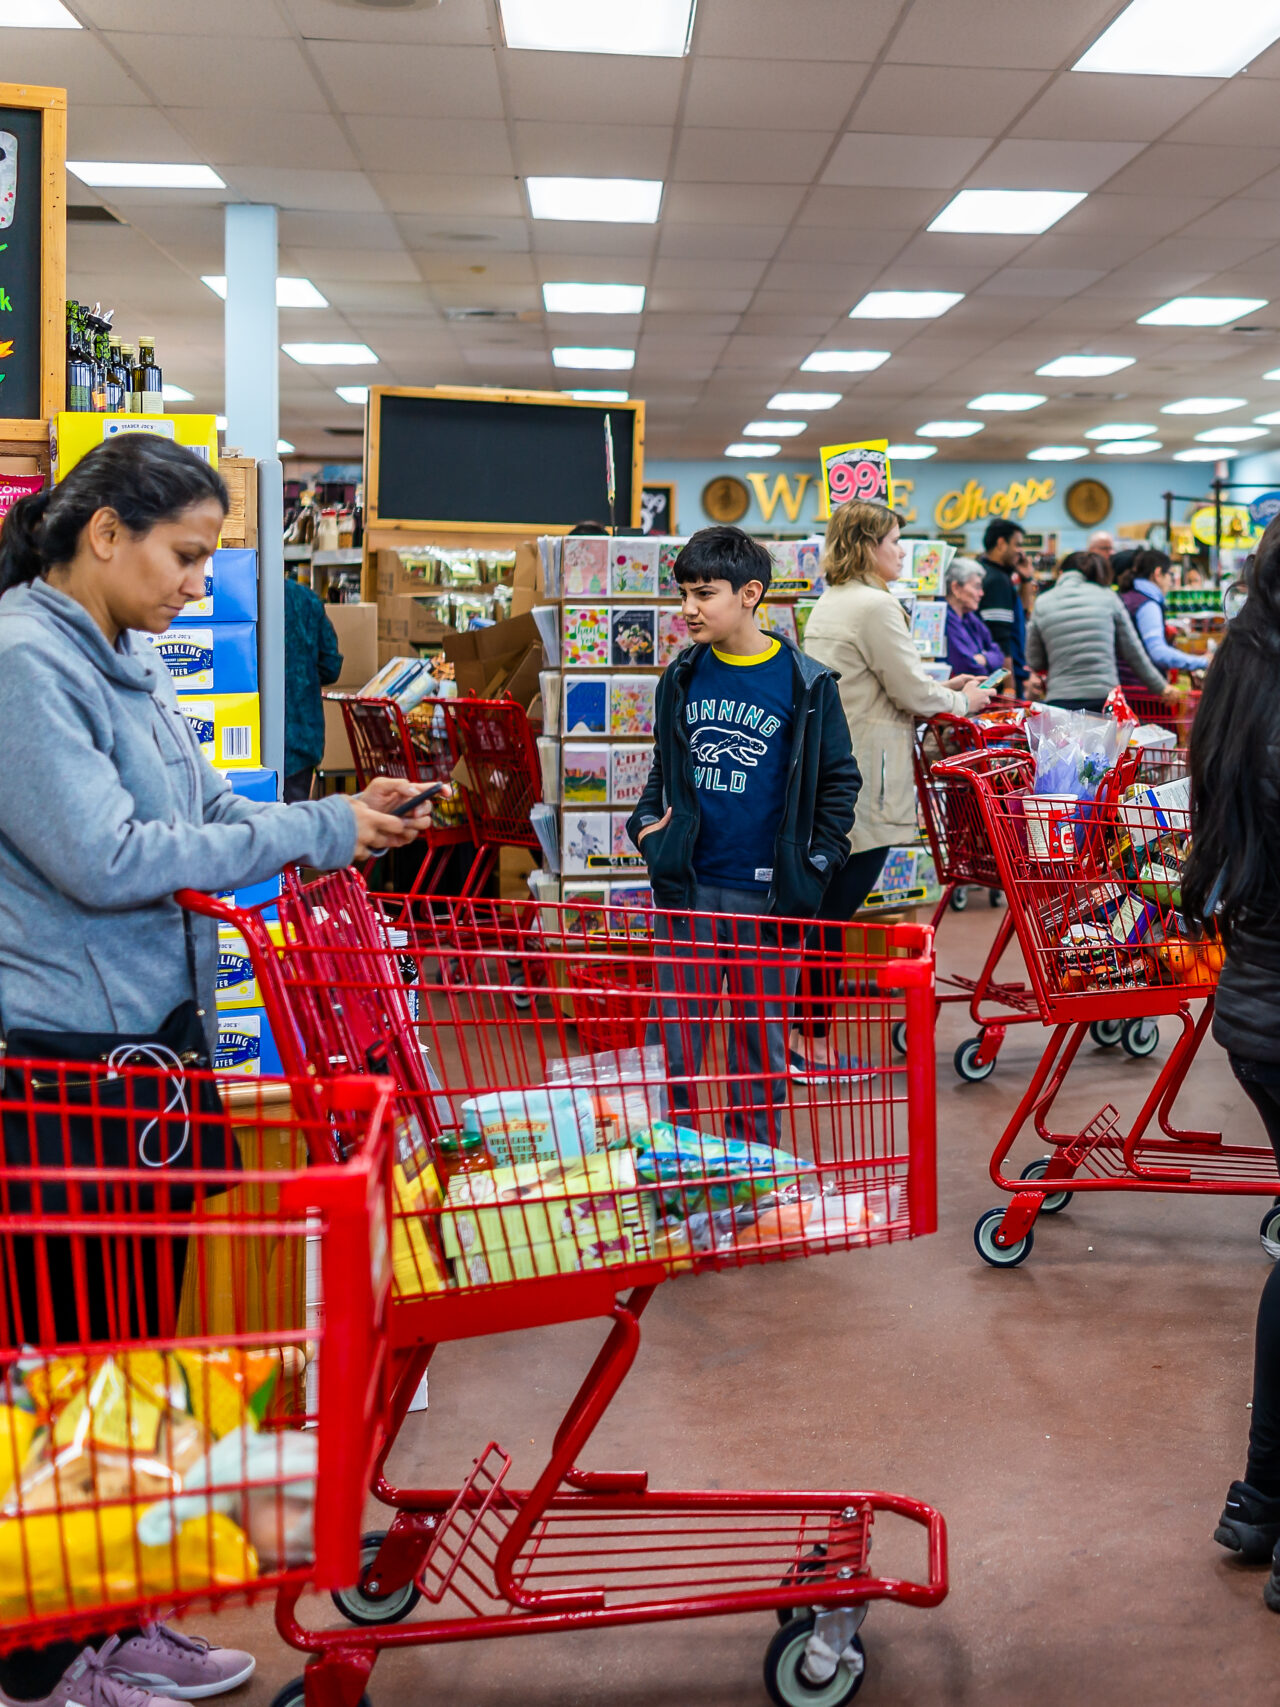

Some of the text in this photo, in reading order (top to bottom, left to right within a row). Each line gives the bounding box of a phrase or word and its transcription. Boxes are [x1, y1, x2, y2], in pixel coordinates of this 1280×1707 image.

[747, 472, 1056, 530] WIE Shoppe
[157, 644, 203, 658] PARKLING
[169, 667, 188, 676] ATER
[686, 699, 781, 738] UNNING
[616, 784, 647, 800] BIK
[219, 1034, 248, 1047] KLING
[214, 1059, 234, 1068] ATER
